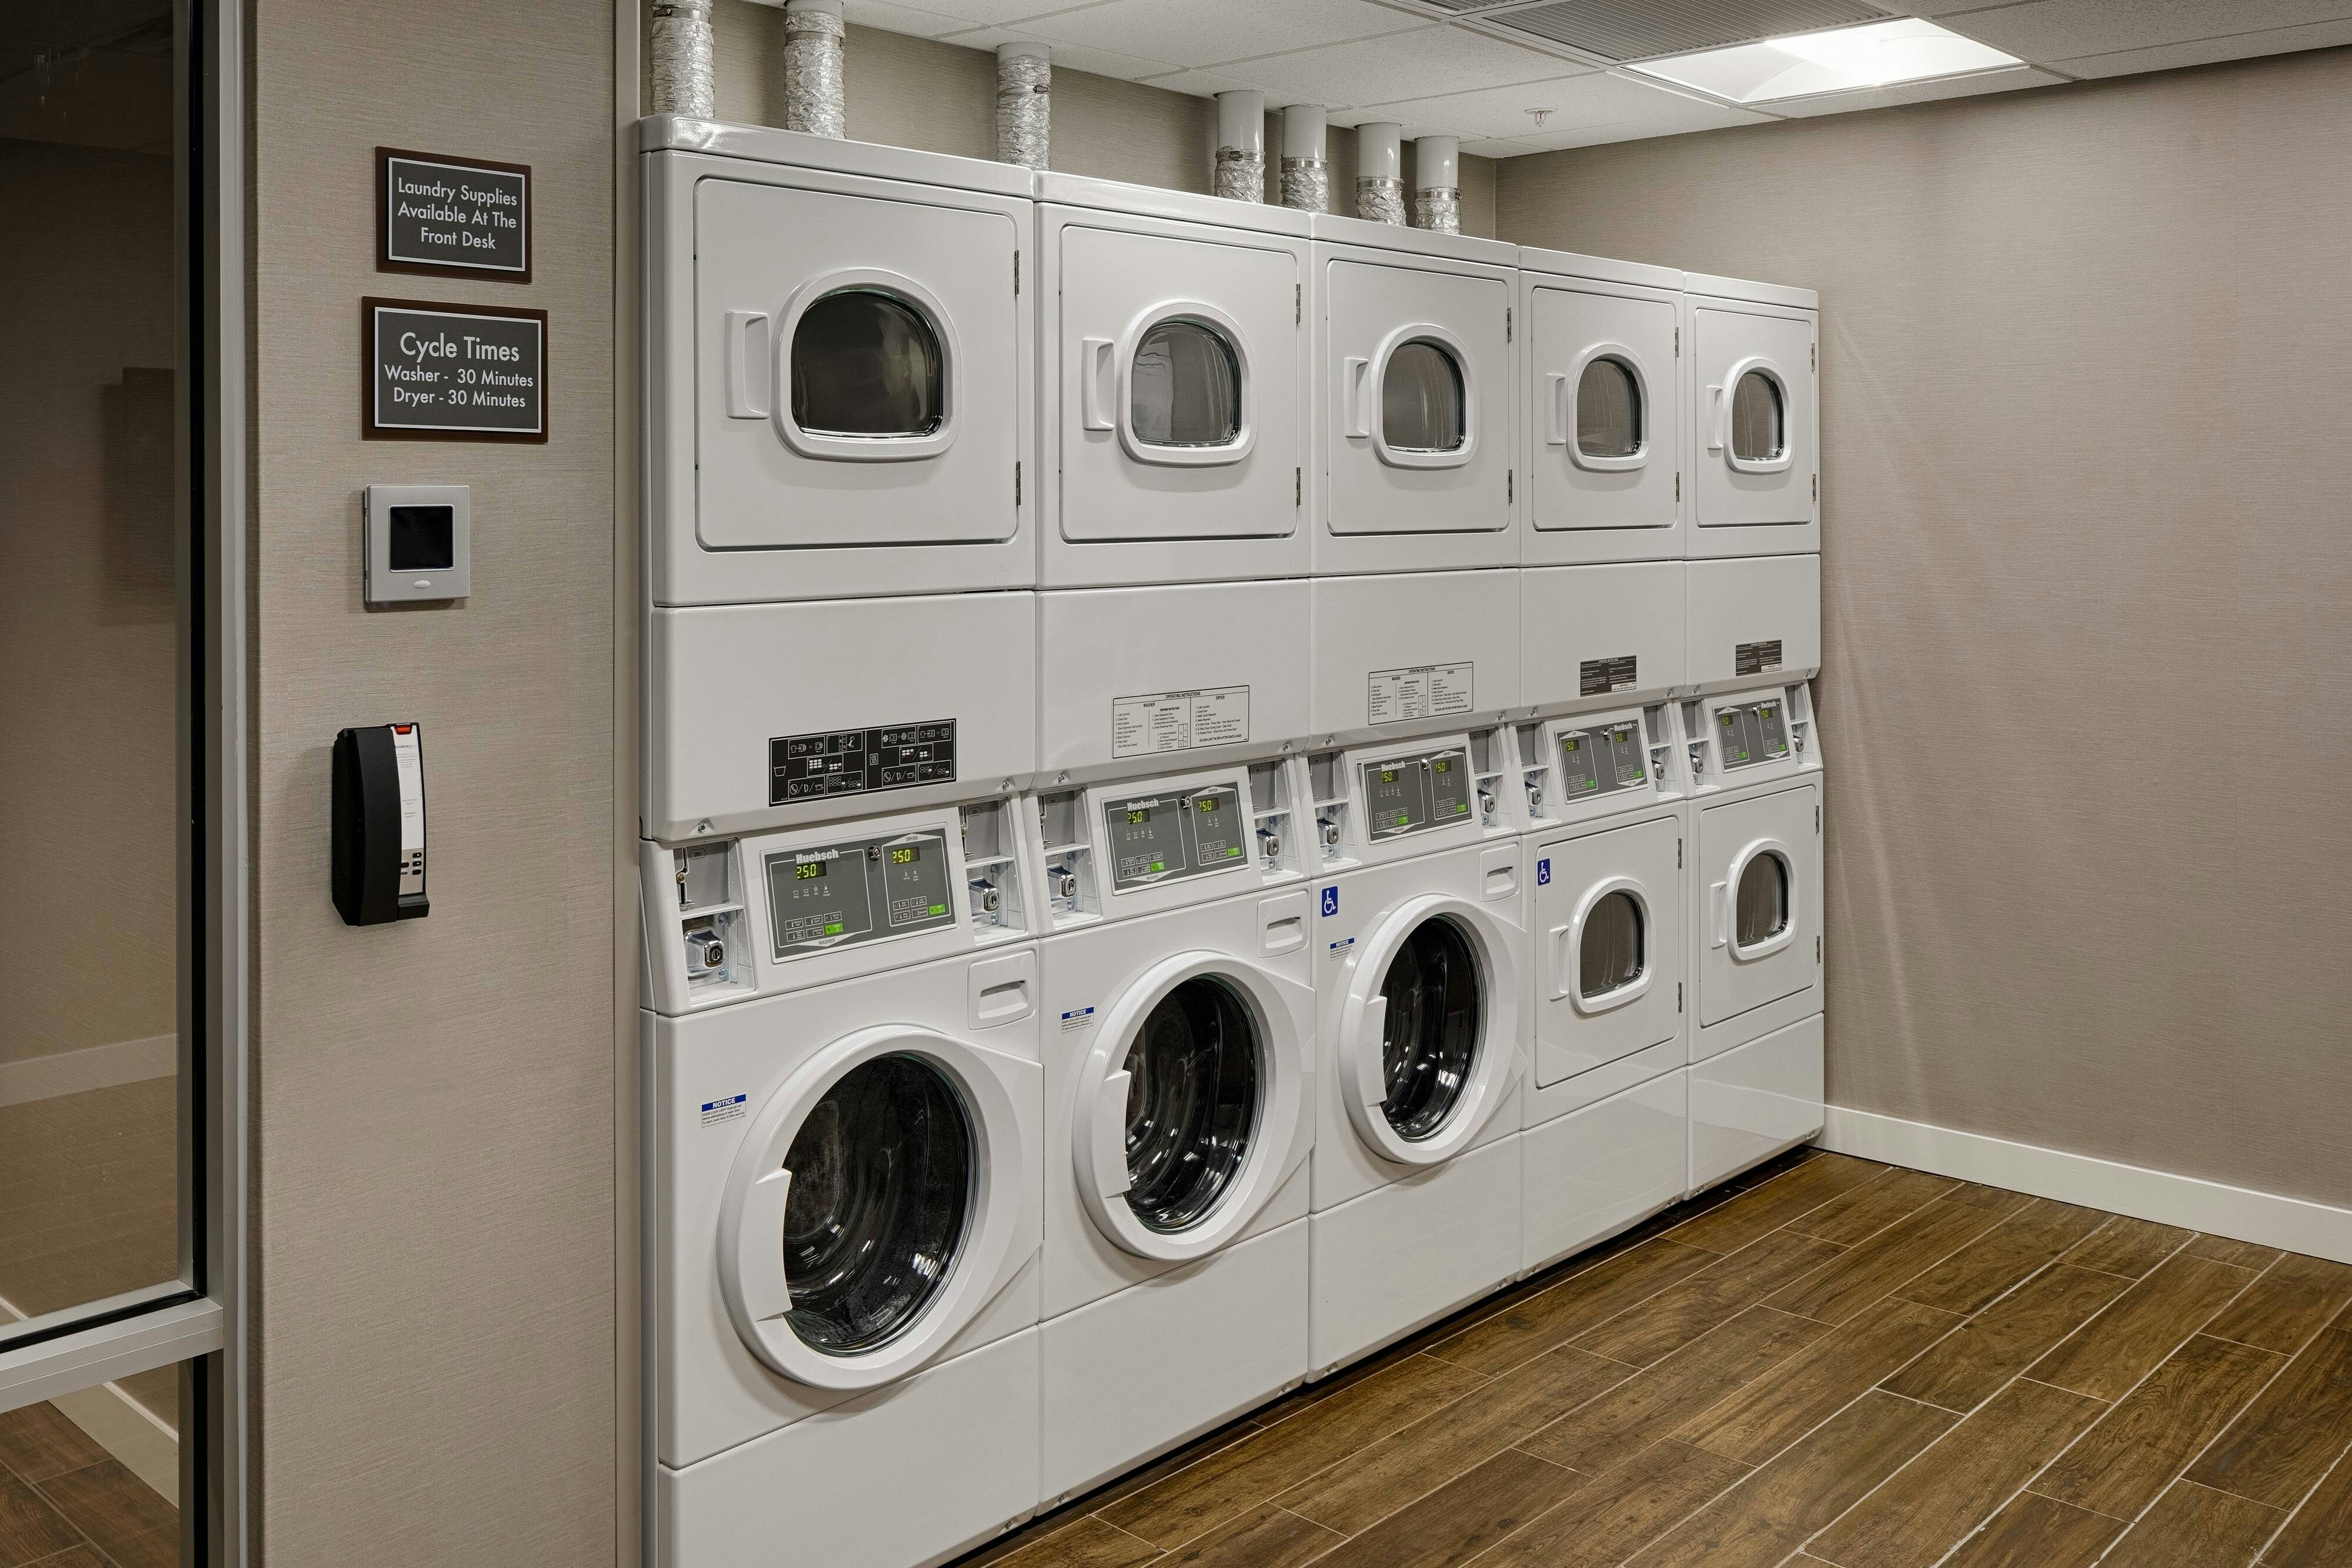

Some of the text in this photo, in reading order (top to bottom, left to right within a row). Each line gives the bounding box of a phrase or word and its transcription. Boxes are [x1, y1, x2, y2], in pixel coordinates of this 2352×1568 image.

[398, 177, 517, 207] Laundry Supplies
[398, 200, 517, 229] Available At The
[421, 227, 496, 249] Front Desk
[400, 332, 520, 363] Cycle Times
[385, 364, 440, 382] Washer
[457, 369, 476, 384] 30
[481, 370, 533, 387] Minutes
[393, 387, 435, 407] Dryer
[448, 390, 467, 405] 30
[472, 390, 526, 407] Minutes
[1381, 761, 1406, 772] Huebsch
[1127, 798, 1160, 811] Huebsch
[796, 848, 839, 864] Huebsch
[1070, 1009, 1087, 1017] NOTICE
[713, 1097, 736, 1108] NOTICE
